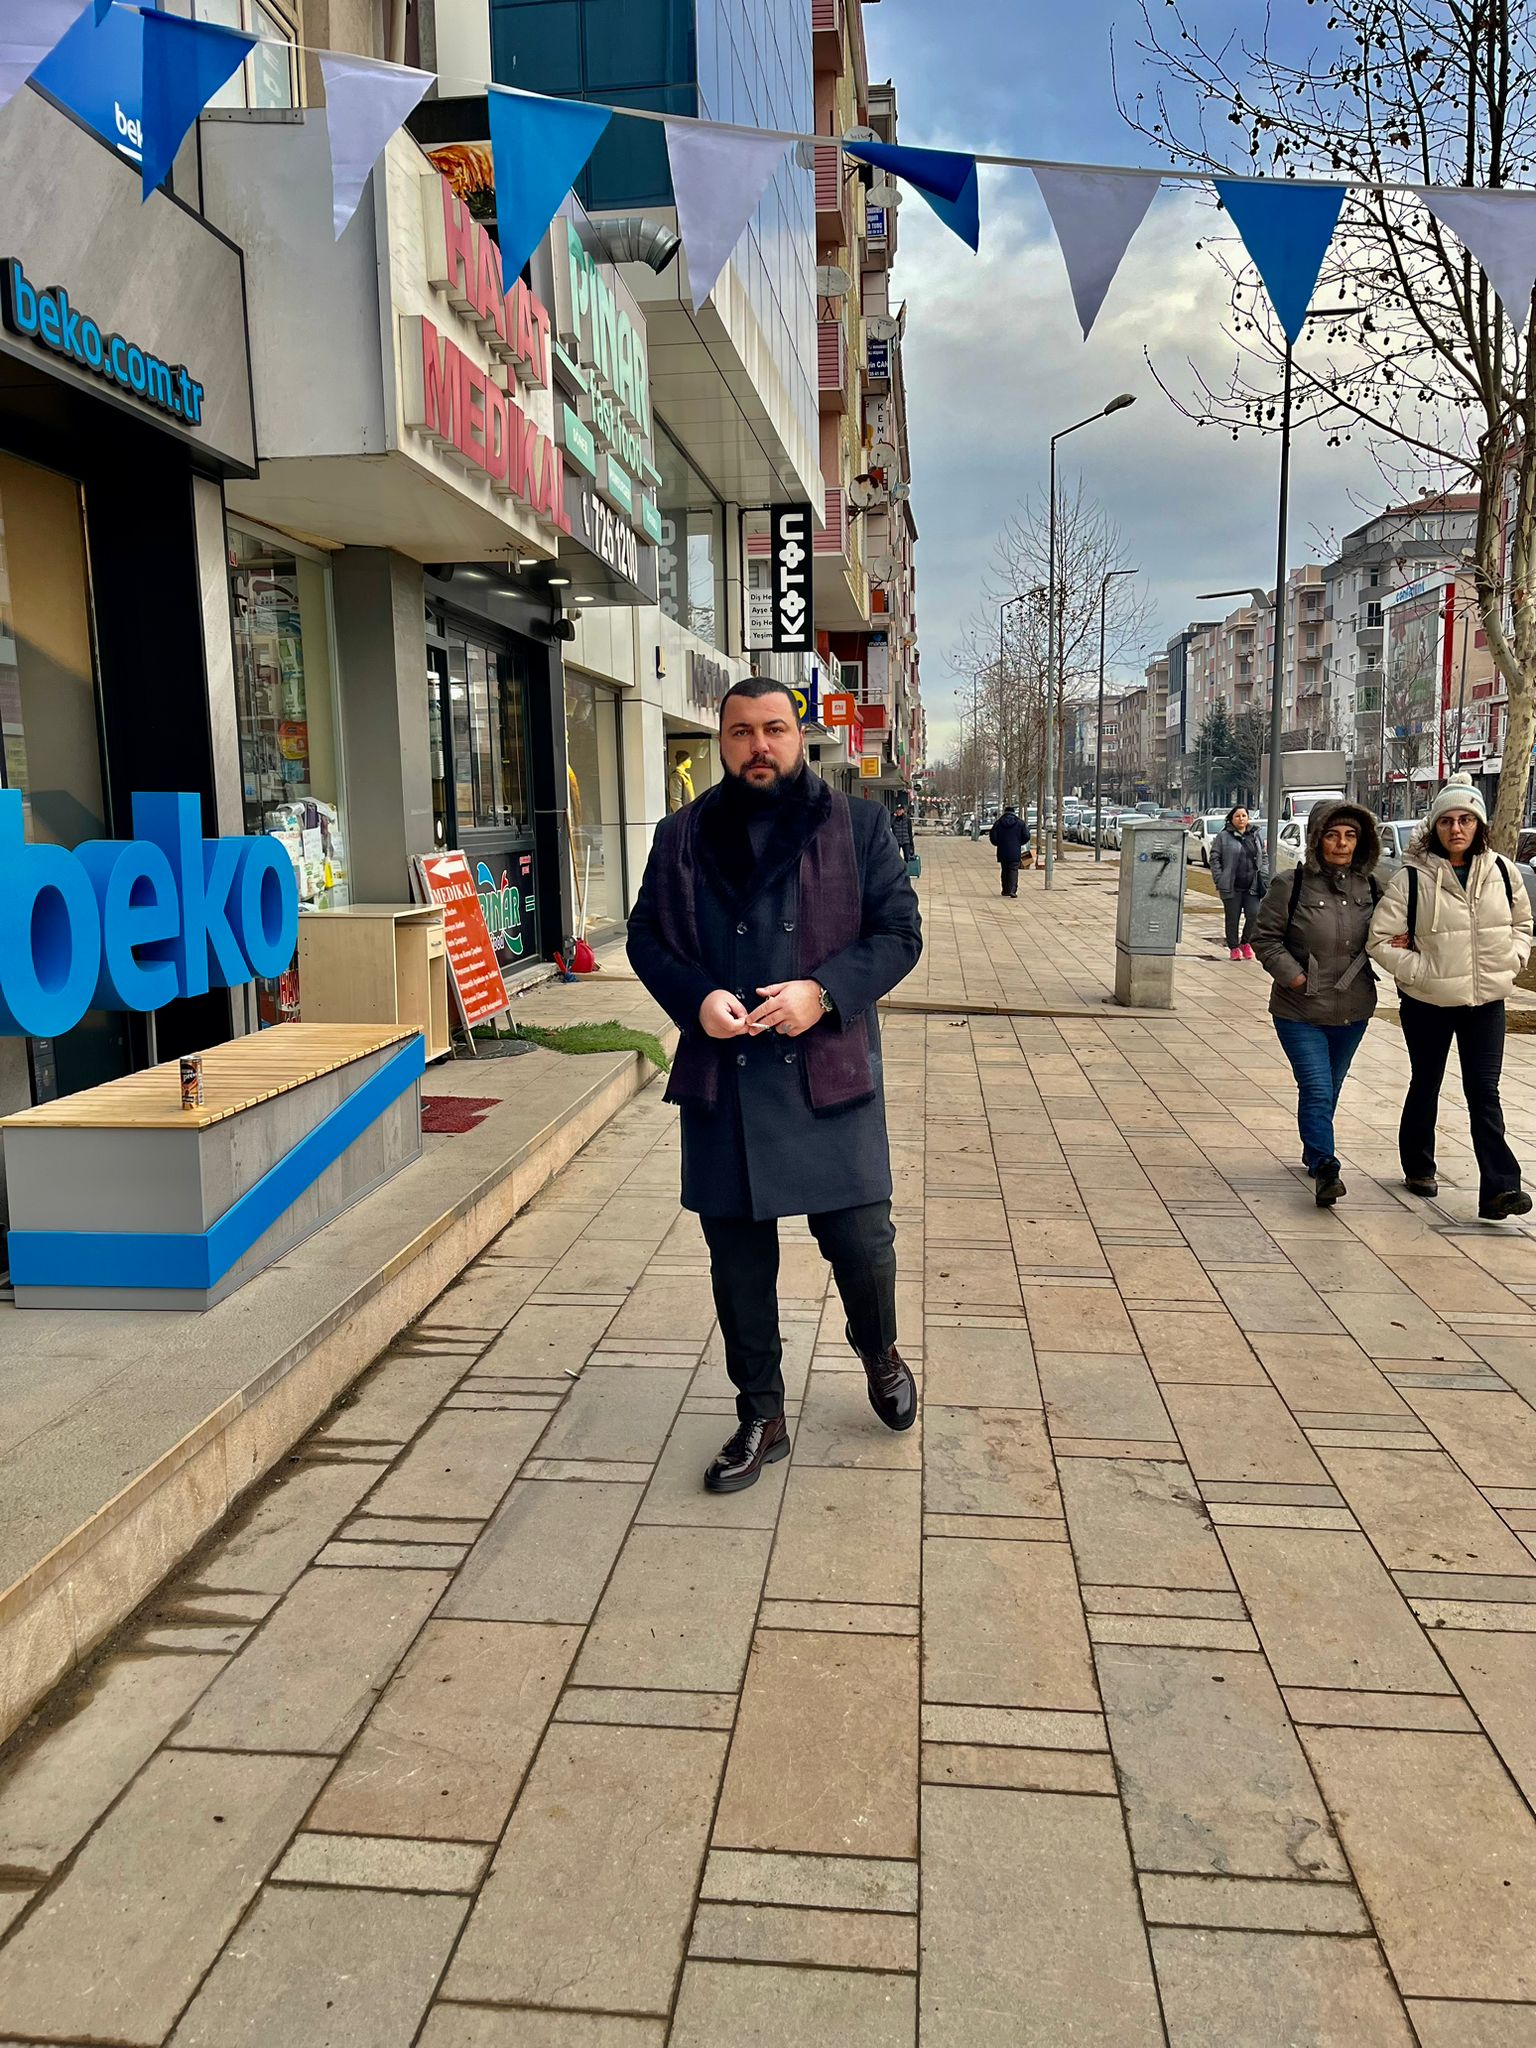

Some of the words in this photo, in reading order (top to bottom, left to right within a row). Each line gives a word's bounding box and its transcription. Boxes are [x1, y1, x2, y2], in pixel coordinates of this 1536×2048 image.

[13, 262, 204, 425] beko.com.tr
[441, 171, 551, 391] HAYAT
[567, 216, 649, 440] PINAR
[592, 493, 614, 565] 726
[614, 516, 638, 585] 1200
[751, 606, 768, 615] Ayşe
[0, 788, 299, 1038] beko
